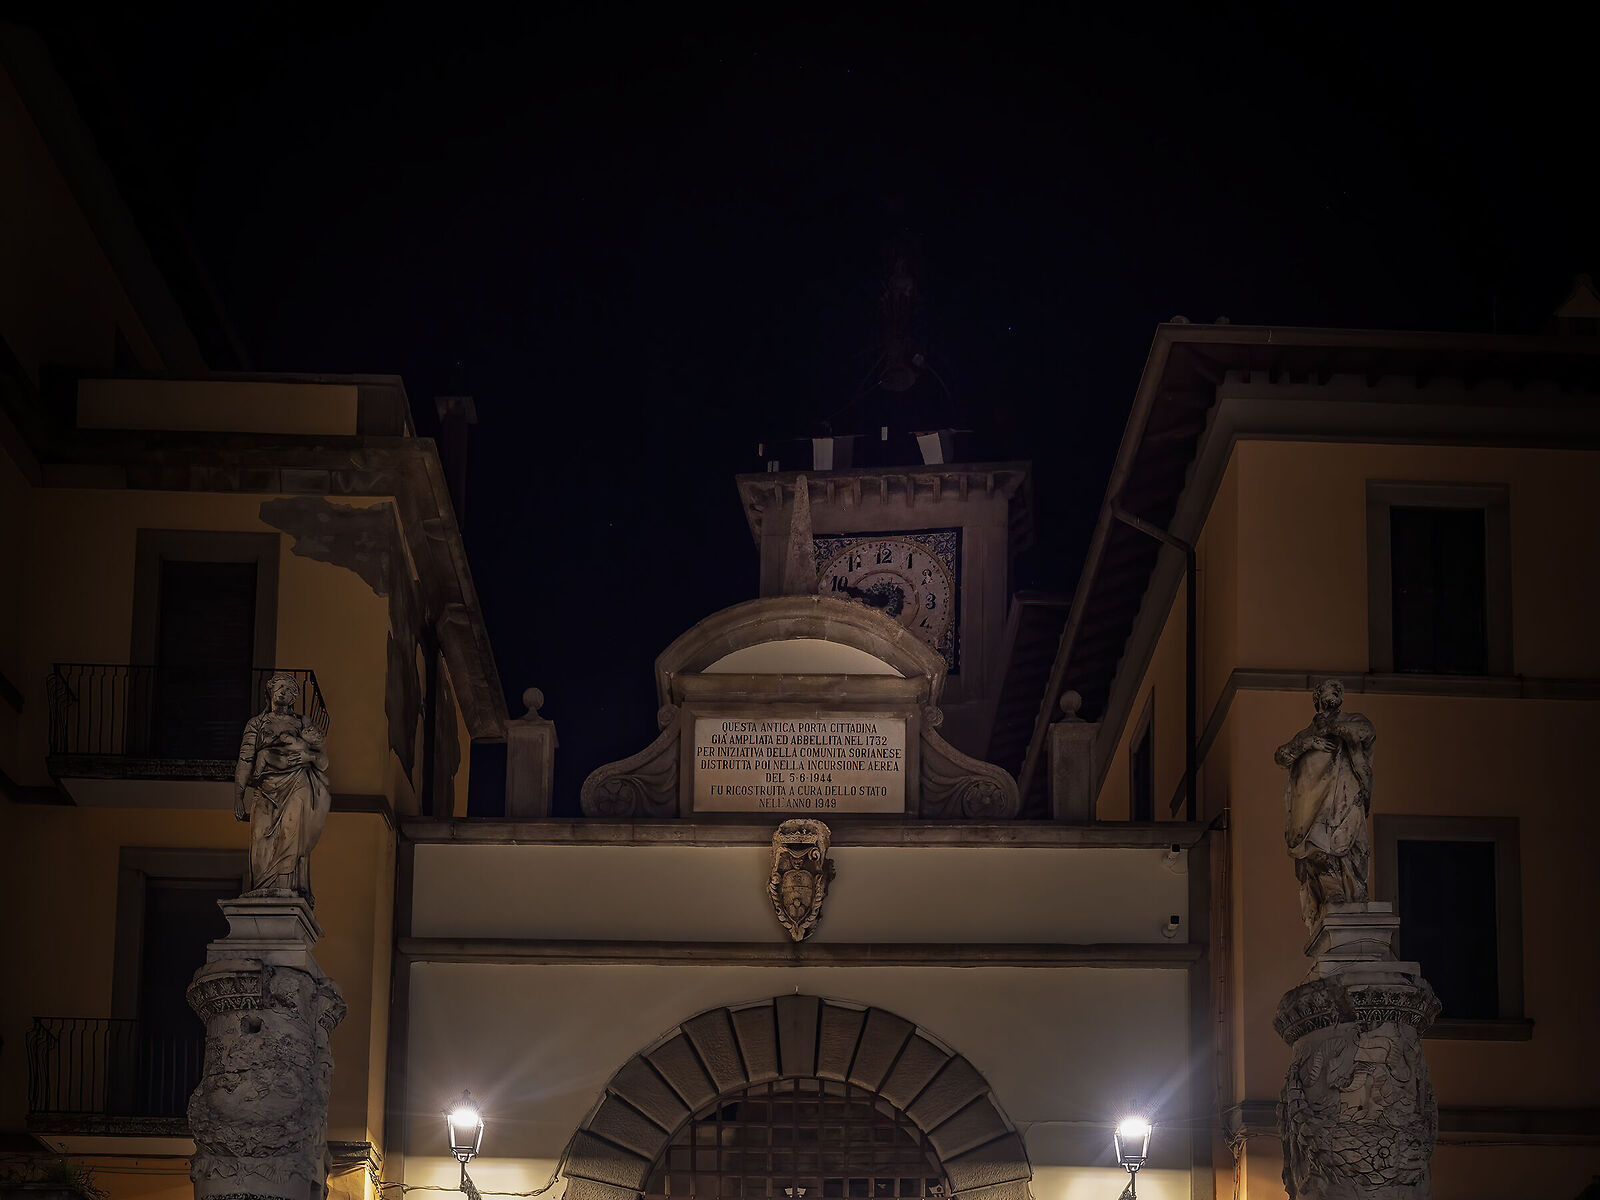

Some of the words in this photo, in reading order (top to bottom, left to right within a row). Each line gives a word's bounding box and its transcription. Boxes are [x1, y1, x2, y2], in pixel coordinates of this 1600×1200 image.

[876, 548, 892, 564] 12
[907, 553, 913, 569] 1
[831, 575, 848, 592] 10
[921, 568, 933, 586] 2
[926, 593, 936, 610] 3
[722, 722, 757, 733] QUESTA
[760, 722, 796, 733] ANTICA
[798, 722, 827, 733] PORTA
[830, 722, 877, 734] CITTADINA
[729, 735, 774, 745] AMPLIATA
[776, 735, 789, 745] ED
[790, 735, 842, 746] ABBELLITA
[844, 735, 863, 746] NEL
[866, 735, 888, 746] 1732
[697, 746, 715, 757] PER
[717, 746, 764, 758] INIZIATIVA
[766, 747, 798, 758] DELLA
[848, 748, 902, 759] SORIANESE
[701, 759, 752, 770] DISTRUTTA
[755, 759, 771, 770] POI
[773, 760, 805, 771] NELLA
[807, 760, 865, 771] INCURSIONE
[867, 760, 899, 772] AEREA
[765, 772, 785, 783] DEL
[711, 785, 724, 796] FU
[725, 785, 787, 796] RICOSTRUITA
[788, 786, 795, 796] A
[797, 785, 822, 796] CURA
[824, 786, 857, 796] DELLO
[858, 786, 887, 797] STATO
[814, 798, 837, 809] 1949
